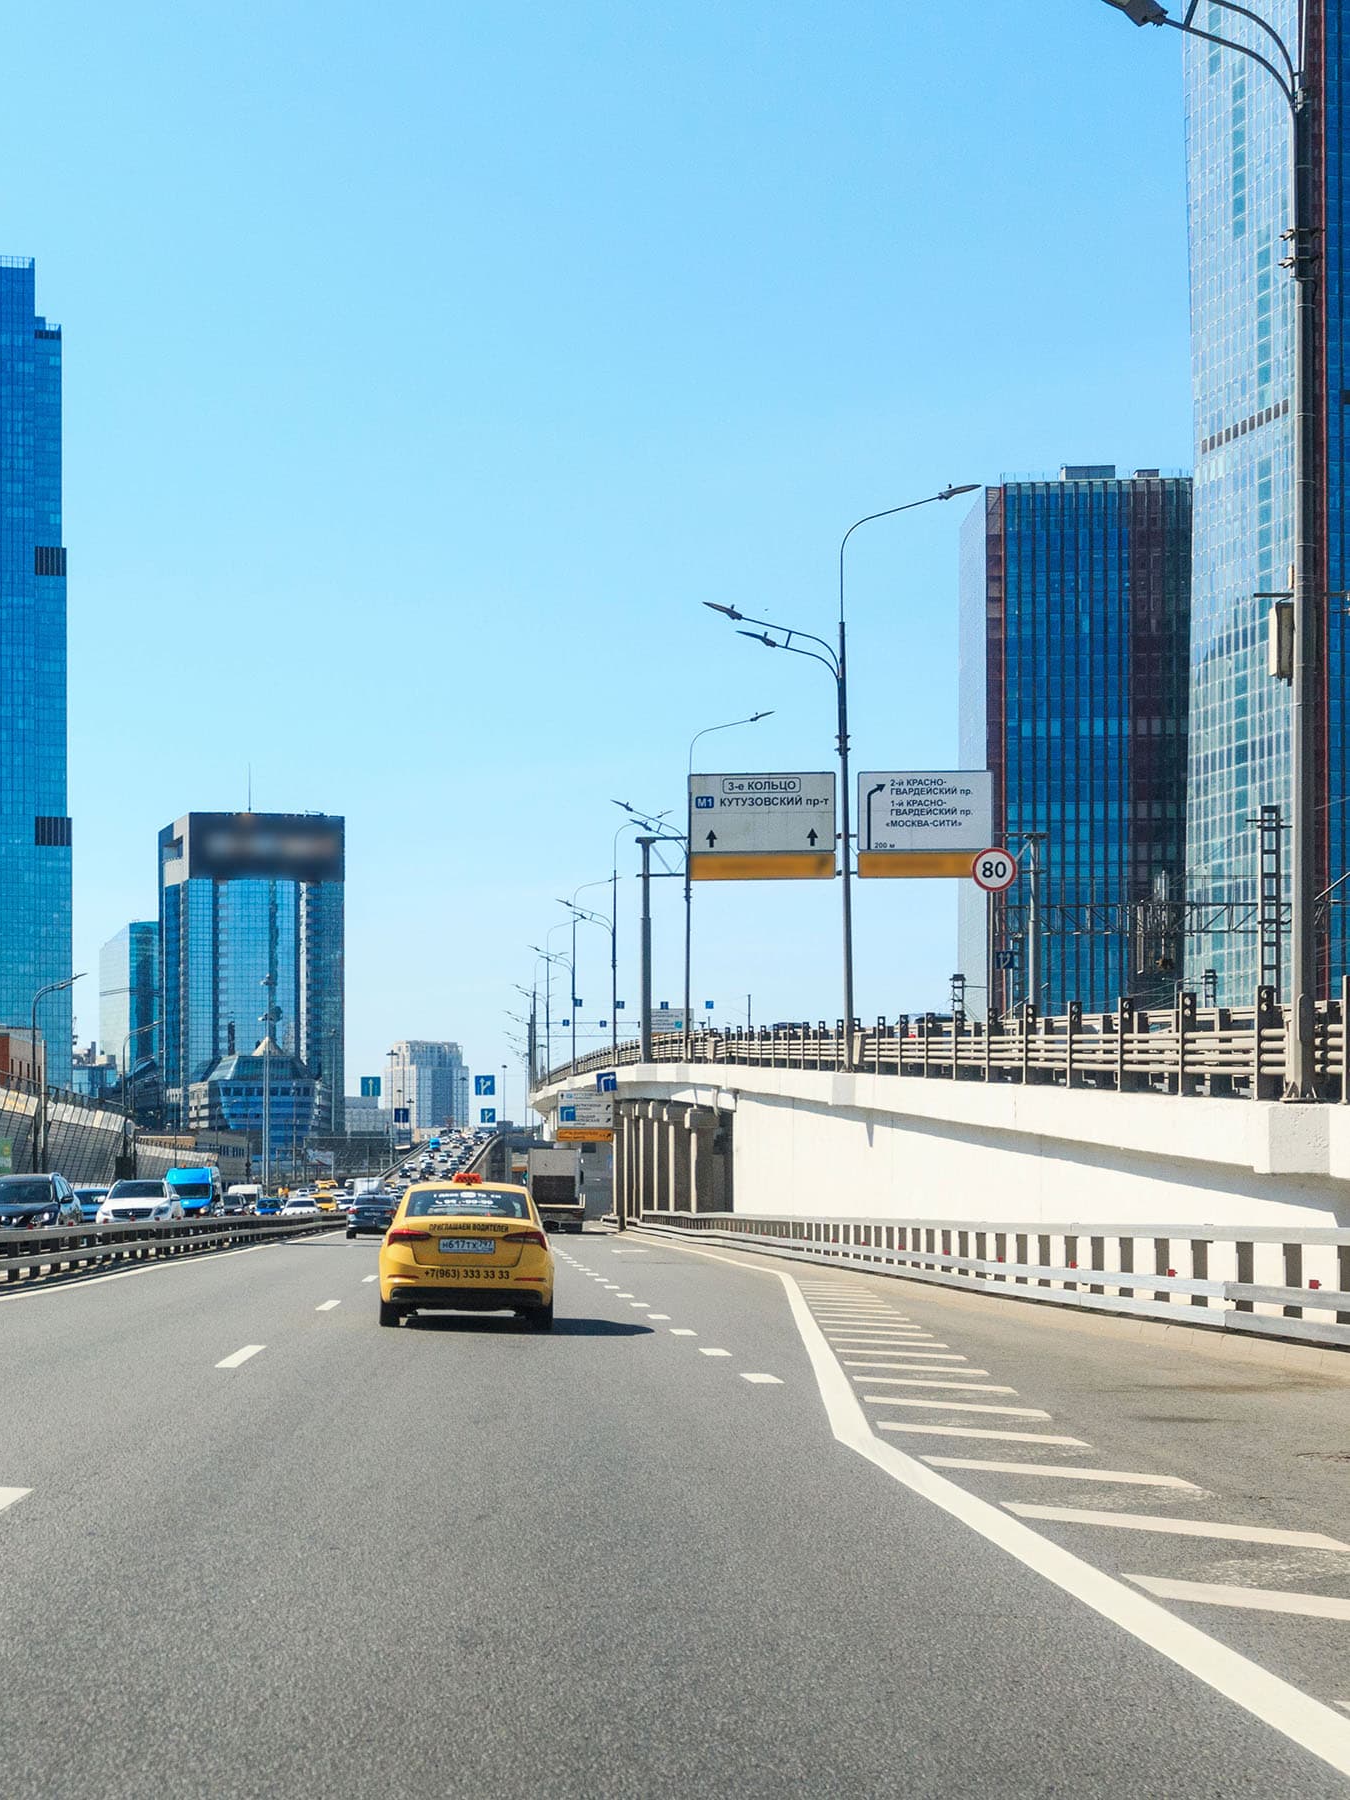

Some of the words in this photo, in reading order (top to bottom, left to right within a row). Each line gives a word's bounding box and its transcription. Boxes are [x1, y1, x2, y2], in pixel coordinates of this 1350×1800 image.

[728, 782, 744, 791] 3-е
[747, 781, 797, 791] КОЛЬЦО
[890, 786, 958, 796] ГВАРДЕЙСКИЙ
[720, 795, 803, 807] КУТУЗОВСКИЙ
[806, 797, 830, 807] пр-т
[906, 799, 947, 807] КРАСНО-
[890, 806, 958, 816] ГВАРДЕЙСКИЙ
[885, 819, 963, 828] «МОСКВА-СИТИ»
[982, 861, 1007, 878] 80
[429, 1223, 470, 1231] ПРИГЛАШАЕМ
[472, 1223, 509, 1232] ВОДИТЕЛЕЙ
[424, 1268, 460, 1280] +7(963)
[463, 1269, 481, 1279] 333
[483, 1270, 495, 1279] 33
[497, 1270, 510, 1280] 33
